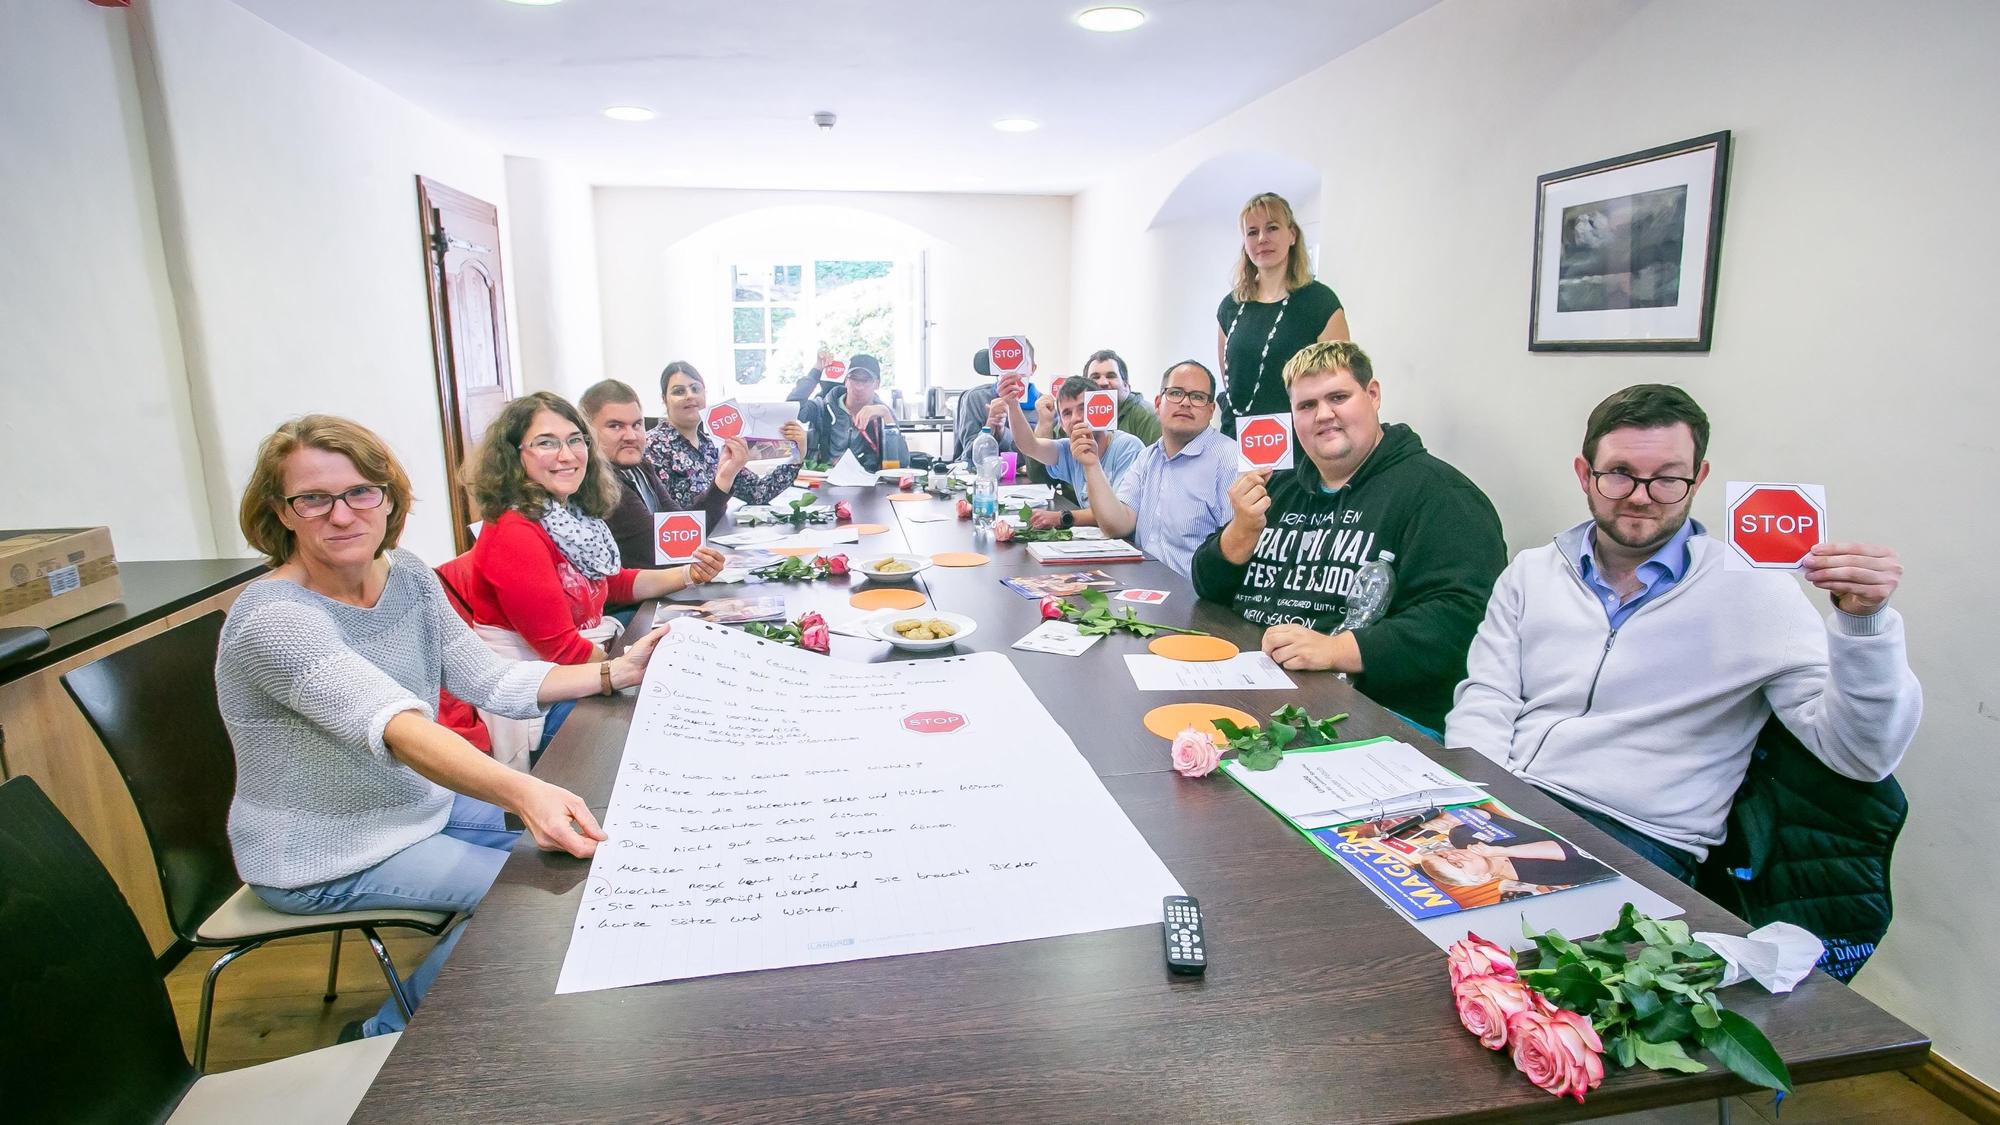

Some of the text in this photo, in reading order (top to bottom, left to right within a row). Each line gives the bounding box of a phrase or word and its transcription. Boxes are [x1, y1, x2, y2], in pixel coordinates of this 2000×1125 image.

[994, 349, 1021, 358] STOP
[1088, 405, 1112, 415] STOP
[711, 413, 738, 430] STOP
[1245, 433, 1284, 448] STOP
[1741, 515, 1813, 535] STOP
[663, 530, 698, 542] STOP
[1313, 602, 1336, 612] WITH
[1243, 608, 1264, 622] NEW
[909, 716, 960, 726] STOP
[630, 820, 661, 830] Die
[618, 839, 650, 850] Die
[673, 843, 714, 853] nicht
[728, 839, 752, 850] gut
[698, 861, 723, 871] mit
[1338, 830, 1453, 908] MAGAZIN
[607, 901, 637, 912] Sie
[650, 899, 693, 909] muss
[836, 880, 859, 890] und
[670, 916, 718, 926] Sätze
[729, 912, 762, 923] und
